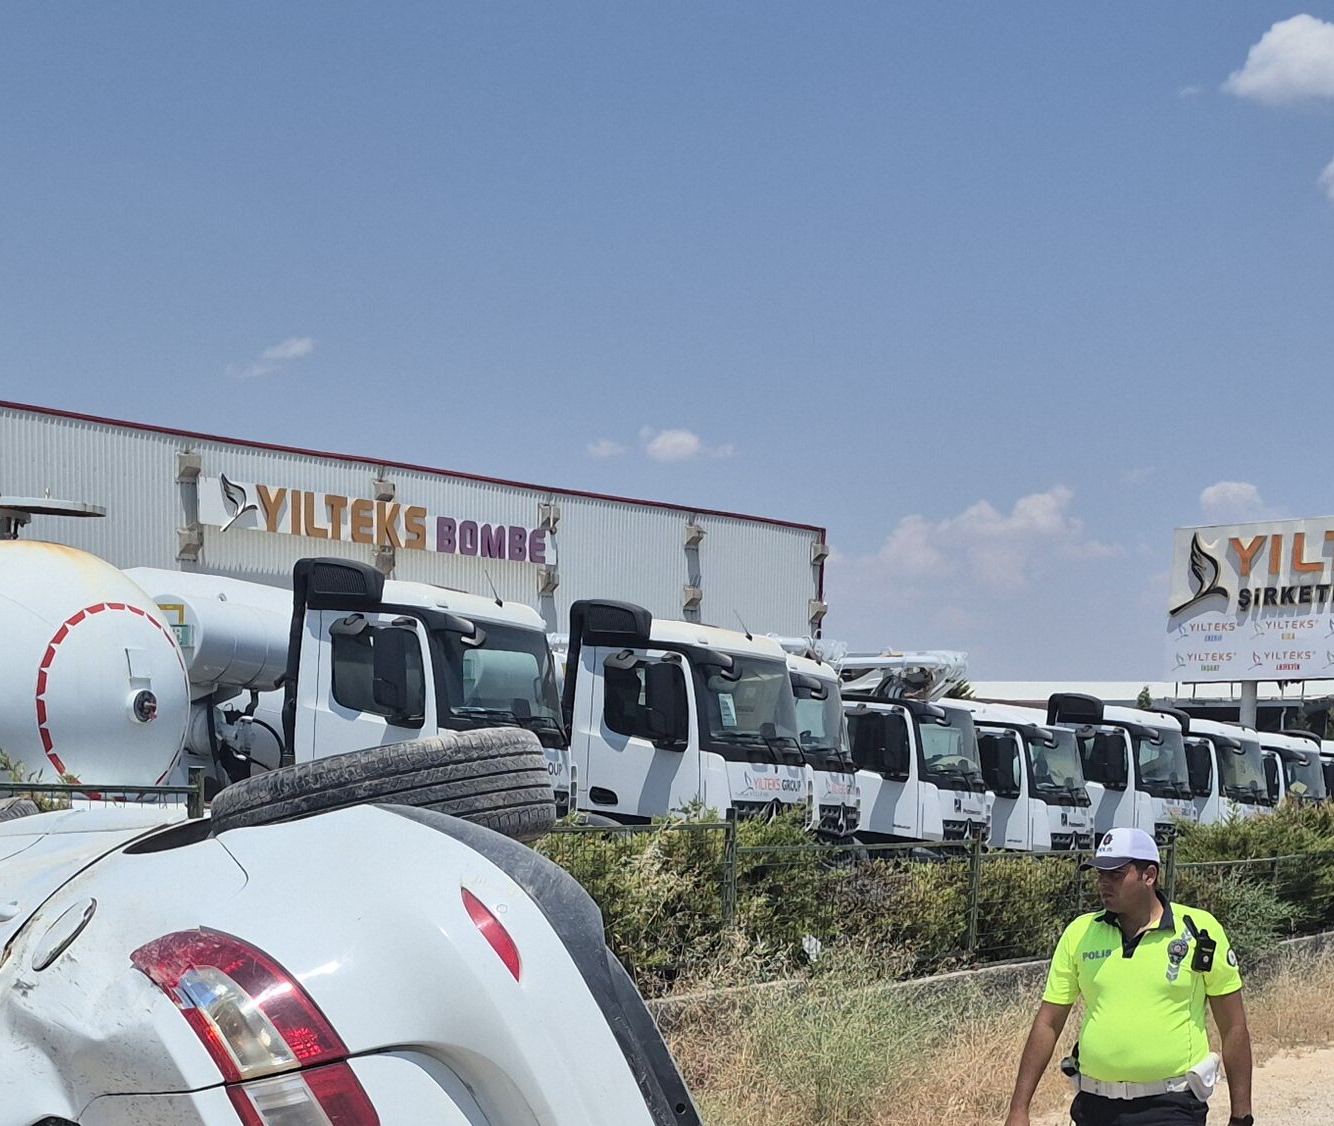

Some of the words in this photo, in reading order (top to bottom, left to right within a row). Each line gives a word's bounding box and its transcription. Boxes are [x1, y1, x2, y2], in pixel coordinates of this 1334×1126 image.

[256, 484, 427, 549] YILTEKS
[436, 516, 546, 564] BOMBE
[1189, 622, 1235, 632] YILTEKS
[1266, 619, 1314, 630] YILTEKS
[1187, 651, 1233, 662] YILTEKS
[1265, 650, 1311, 660] YILTEKS
[547, 761, 563, 776] OUP
